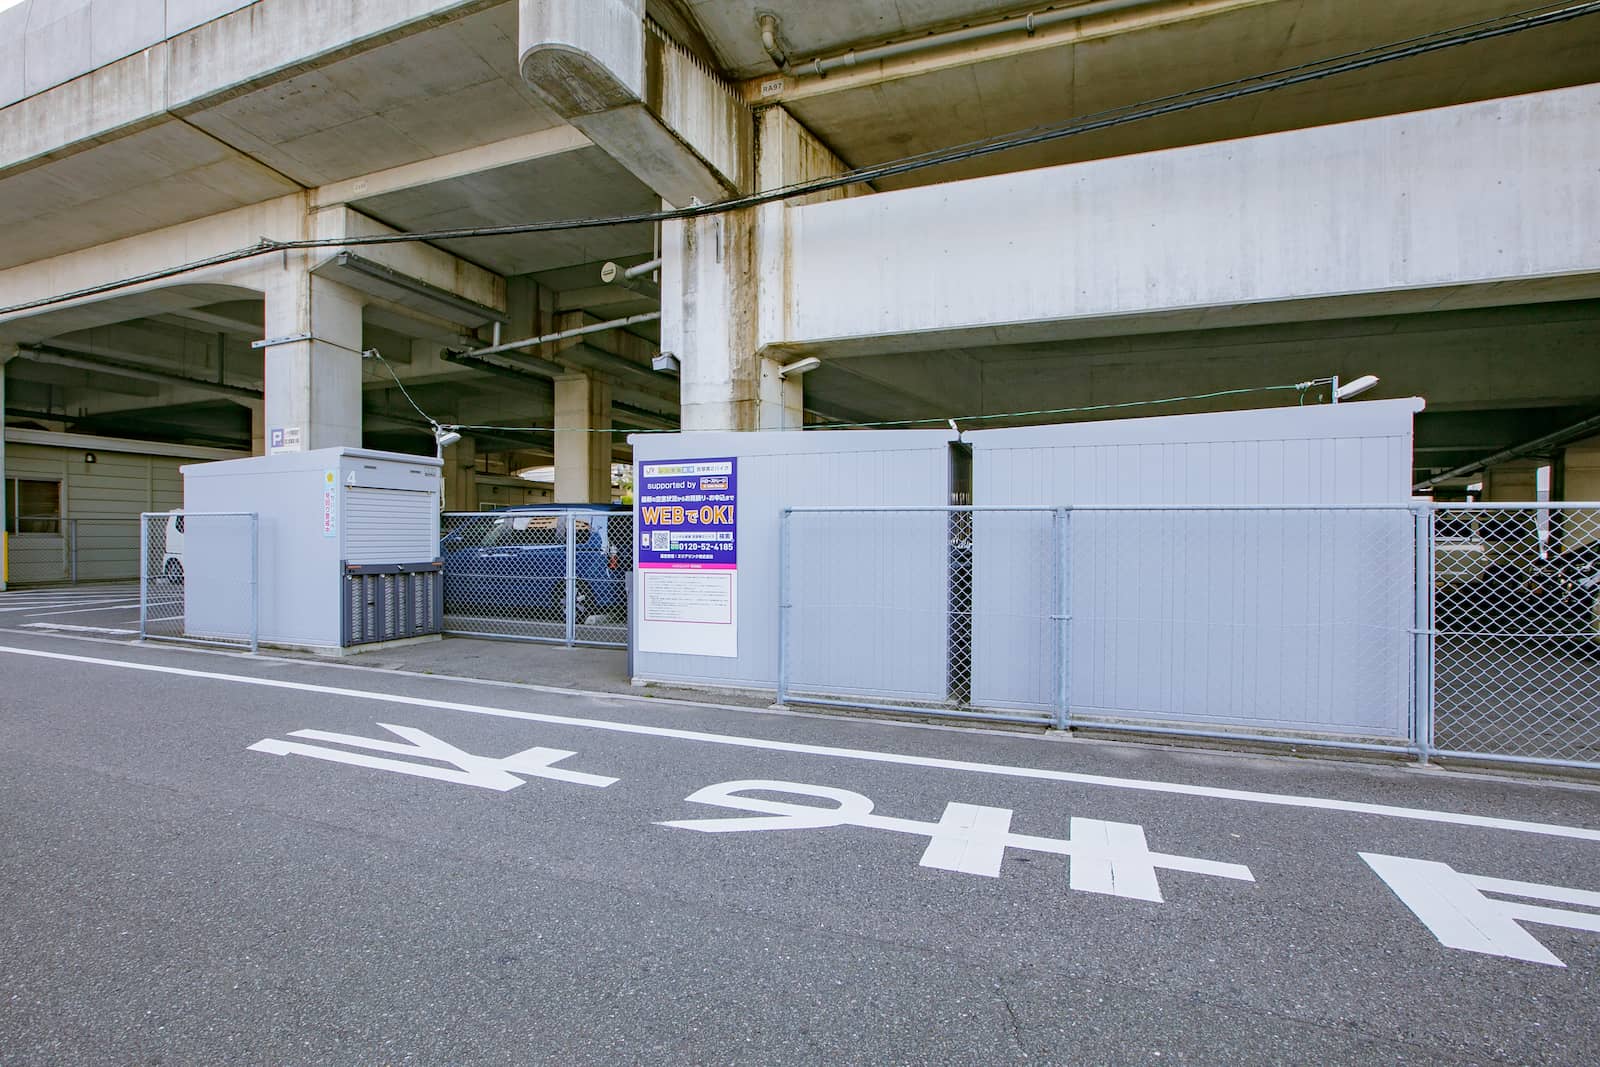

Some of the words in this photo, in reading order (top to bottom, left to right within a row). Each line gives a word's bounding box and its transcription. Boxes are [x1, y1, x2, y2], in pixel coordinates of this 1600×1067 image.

[346, 470, 356, 483] 4
[647, 481, 685, 490] supported
[687, 481, 696, 489] by
[641, 505, 734, 525] WEBでOK!
[679, 543, 733, 551] 0120-52-4185
